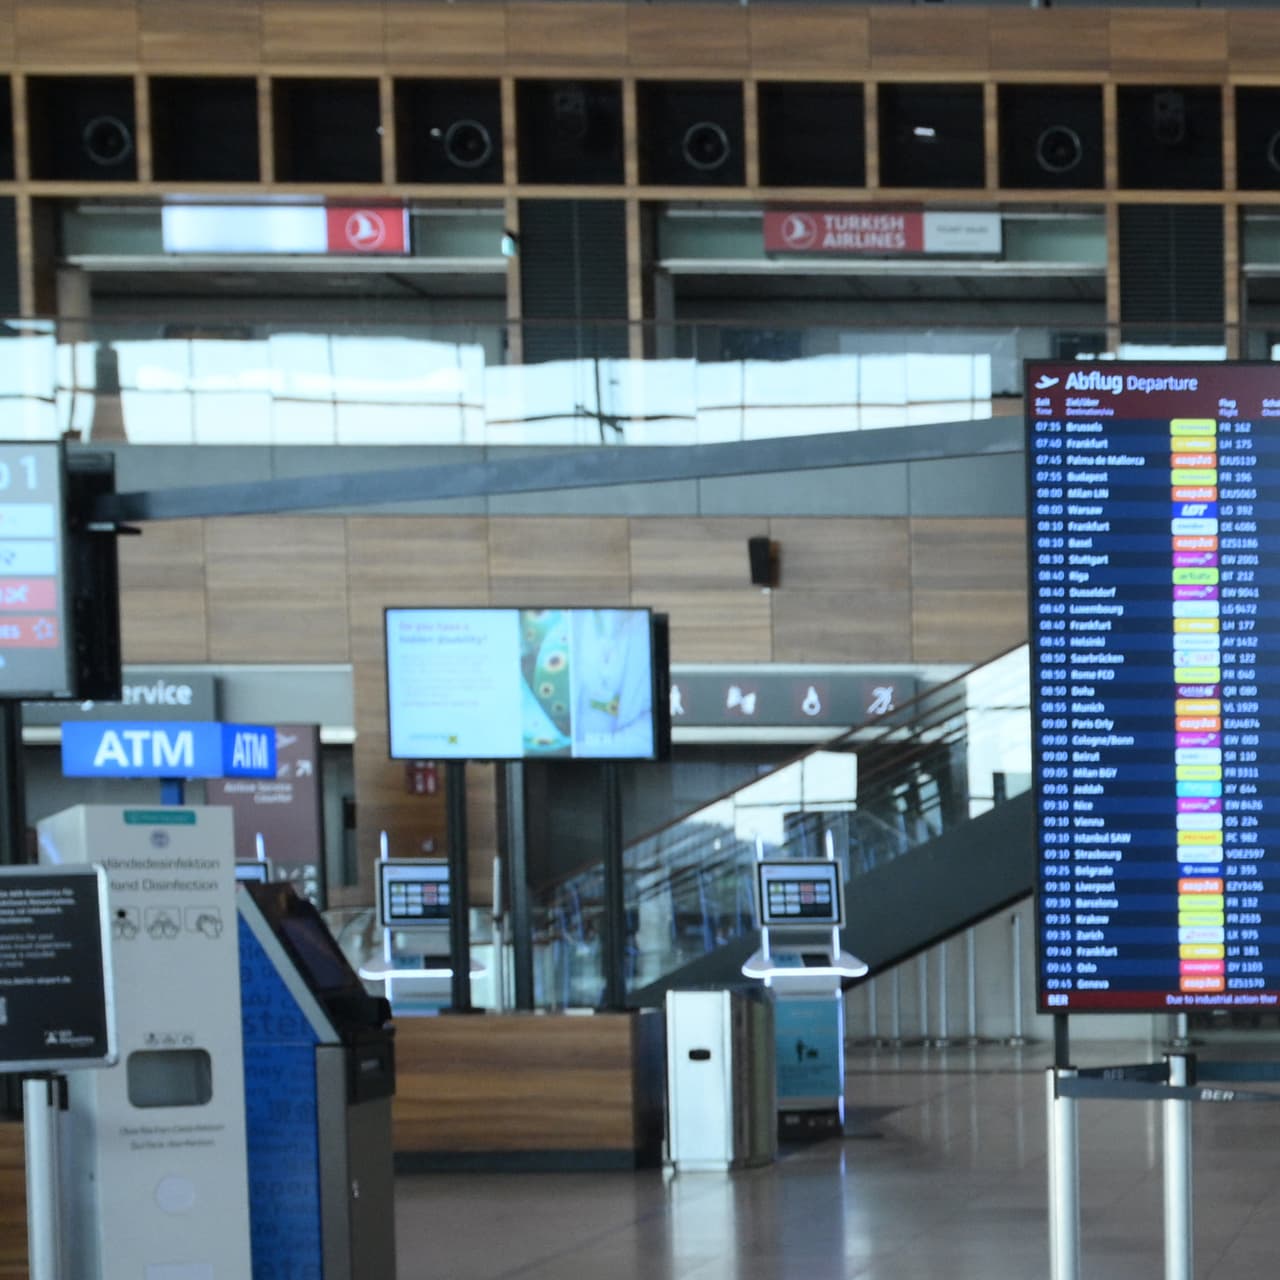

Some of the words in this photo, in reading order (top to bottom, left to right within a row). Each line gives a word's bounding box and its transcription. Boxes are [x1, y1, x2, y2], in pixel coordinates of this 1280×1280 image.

[823, 214, 905, 231] TURKISH
[822, 232, 907, 249] AIRLINES
[1065, 371, 1123, 395] Abflug
[1127, 376, 1198, 394] Departure
[1066, 422, 1104, 432] Brussels
[1067, 439, 1109, 448] Frankfurt
[1067, 455, 1095, 465] Palma
[1095, 455, 1107, 465] de
[1107, 455, 1146, 465] Mallorca
[1068, 488, 1094, 498] Milan
[1068, 506, 1104, 515] Warsaw
[1068, 522, 1110, 531] Frankfurt
[1068, 538, 1093, 548] Basel
[1069, 555, 1109, 566] Stuttgart
[1069, 571, 1090, 582] Riga
[1070, 605, 1124, 615] Luxembourg
[1070, 620, 1112, 630] Frankfurt
[1070, 637, 1106, 646] Helsinki
[1071, 653, 1125, 663] Saarbrücken
[1071, 670, 1097, 679] Rome
[1071, 686, 1096, 696] Doha
[1072, 703, 1105, 712] Munich
[1072, 719, 1094, 730] Paris
[1094, 719, 1115, 730] Orly
[1072, 735, 1135, 746] Cologne/Bonn
[93, 730, 194, 767] ATM
[233, 732, 269, 769] ATM
[1073, 768, 1099, 778] Milan
[1099, 768, 1118, 778] BGY
[1073, 801, 1094, 810] Nice
[1074, 817, 1105, 827] Vienna
[1074, 833, 1110, 843] Istanbul
[1110, 833, 1132, 843] SAW
[1075, 850, 1123, 861] Strasbourg
[1075, 866, 1114, 877] Belgrade
[1075, 882, 1116, 893] Liverpool
[1076, 898, 1119, 908] Barcelona
[1076, 946, 1118, 956] Frankfurt
[1077, 979, 1110, 989] Geneva
[1047, 994, 1069, 1006] BER
[1201, 1089, 1234, 1101] BER
